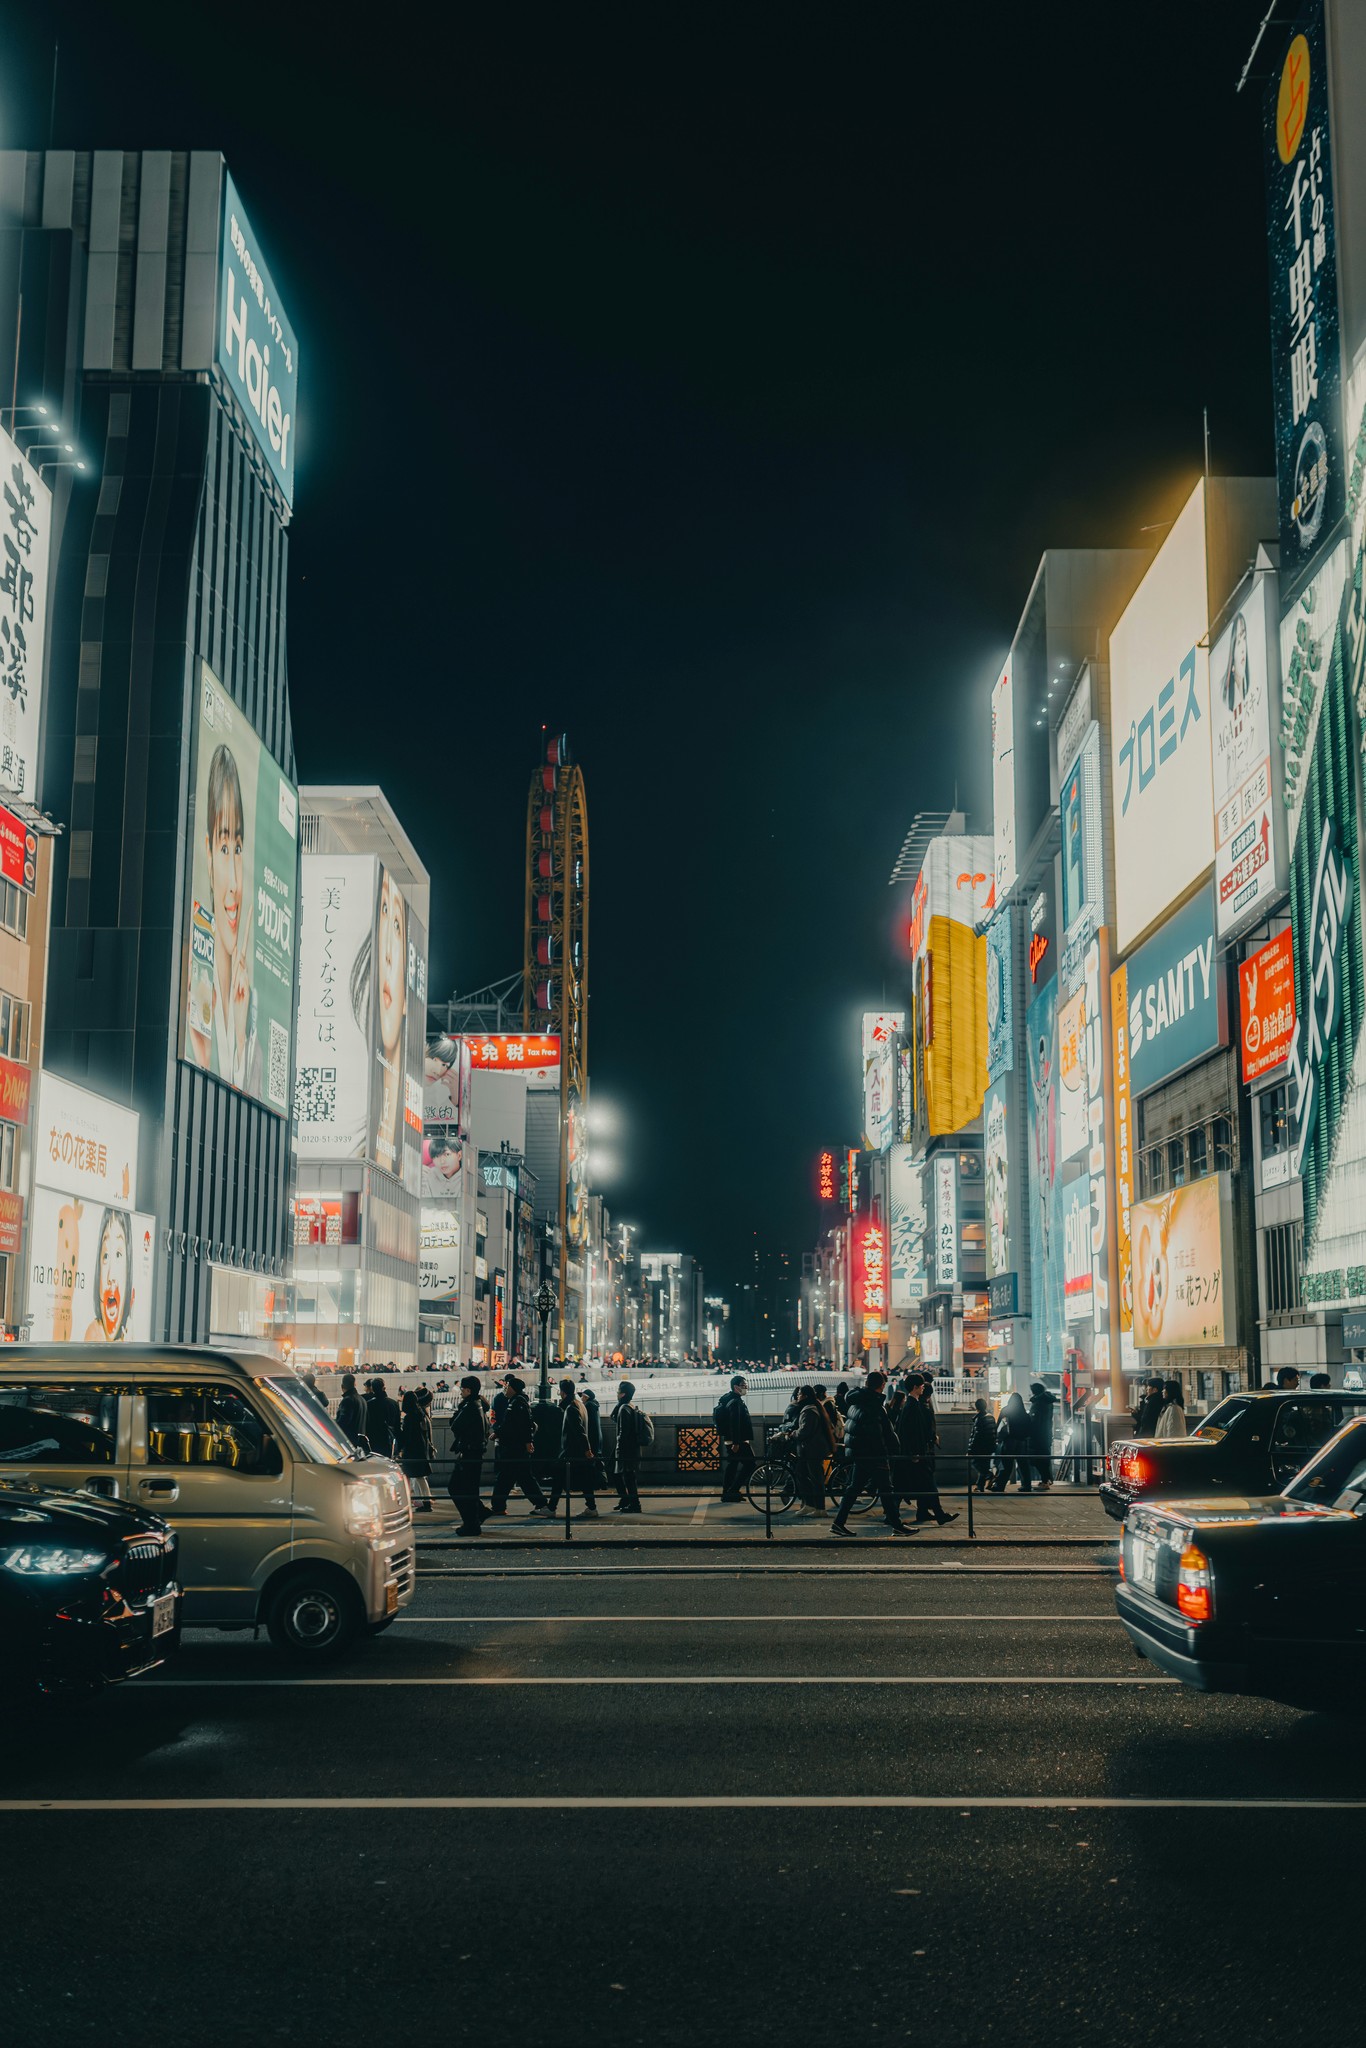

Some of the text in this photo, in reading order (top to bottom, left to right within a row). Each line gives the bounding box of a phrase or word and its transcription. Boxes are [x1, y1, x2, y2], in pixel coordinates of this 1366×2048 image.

[1284, 159, 1320, 427] 千里眼
[225, 267, 291, 470] Haier
[1119, 644, 1202, 818] プロミス
[193, 927, 215, 965] サロンパス
[257, 885, 292, 956] サロンパス
[1145, 935, 1213, 1041] SAMTY
[481, 1043, 557, 1061] 免税 Tax Free
[49, 1125, 107, 1178] なの花薬局
[820, 1152, 833, 1198] お好み焼
[861, 1227, 884, 1308] 大阪王将
[940, 1223, 954, 1280] かに道楽
